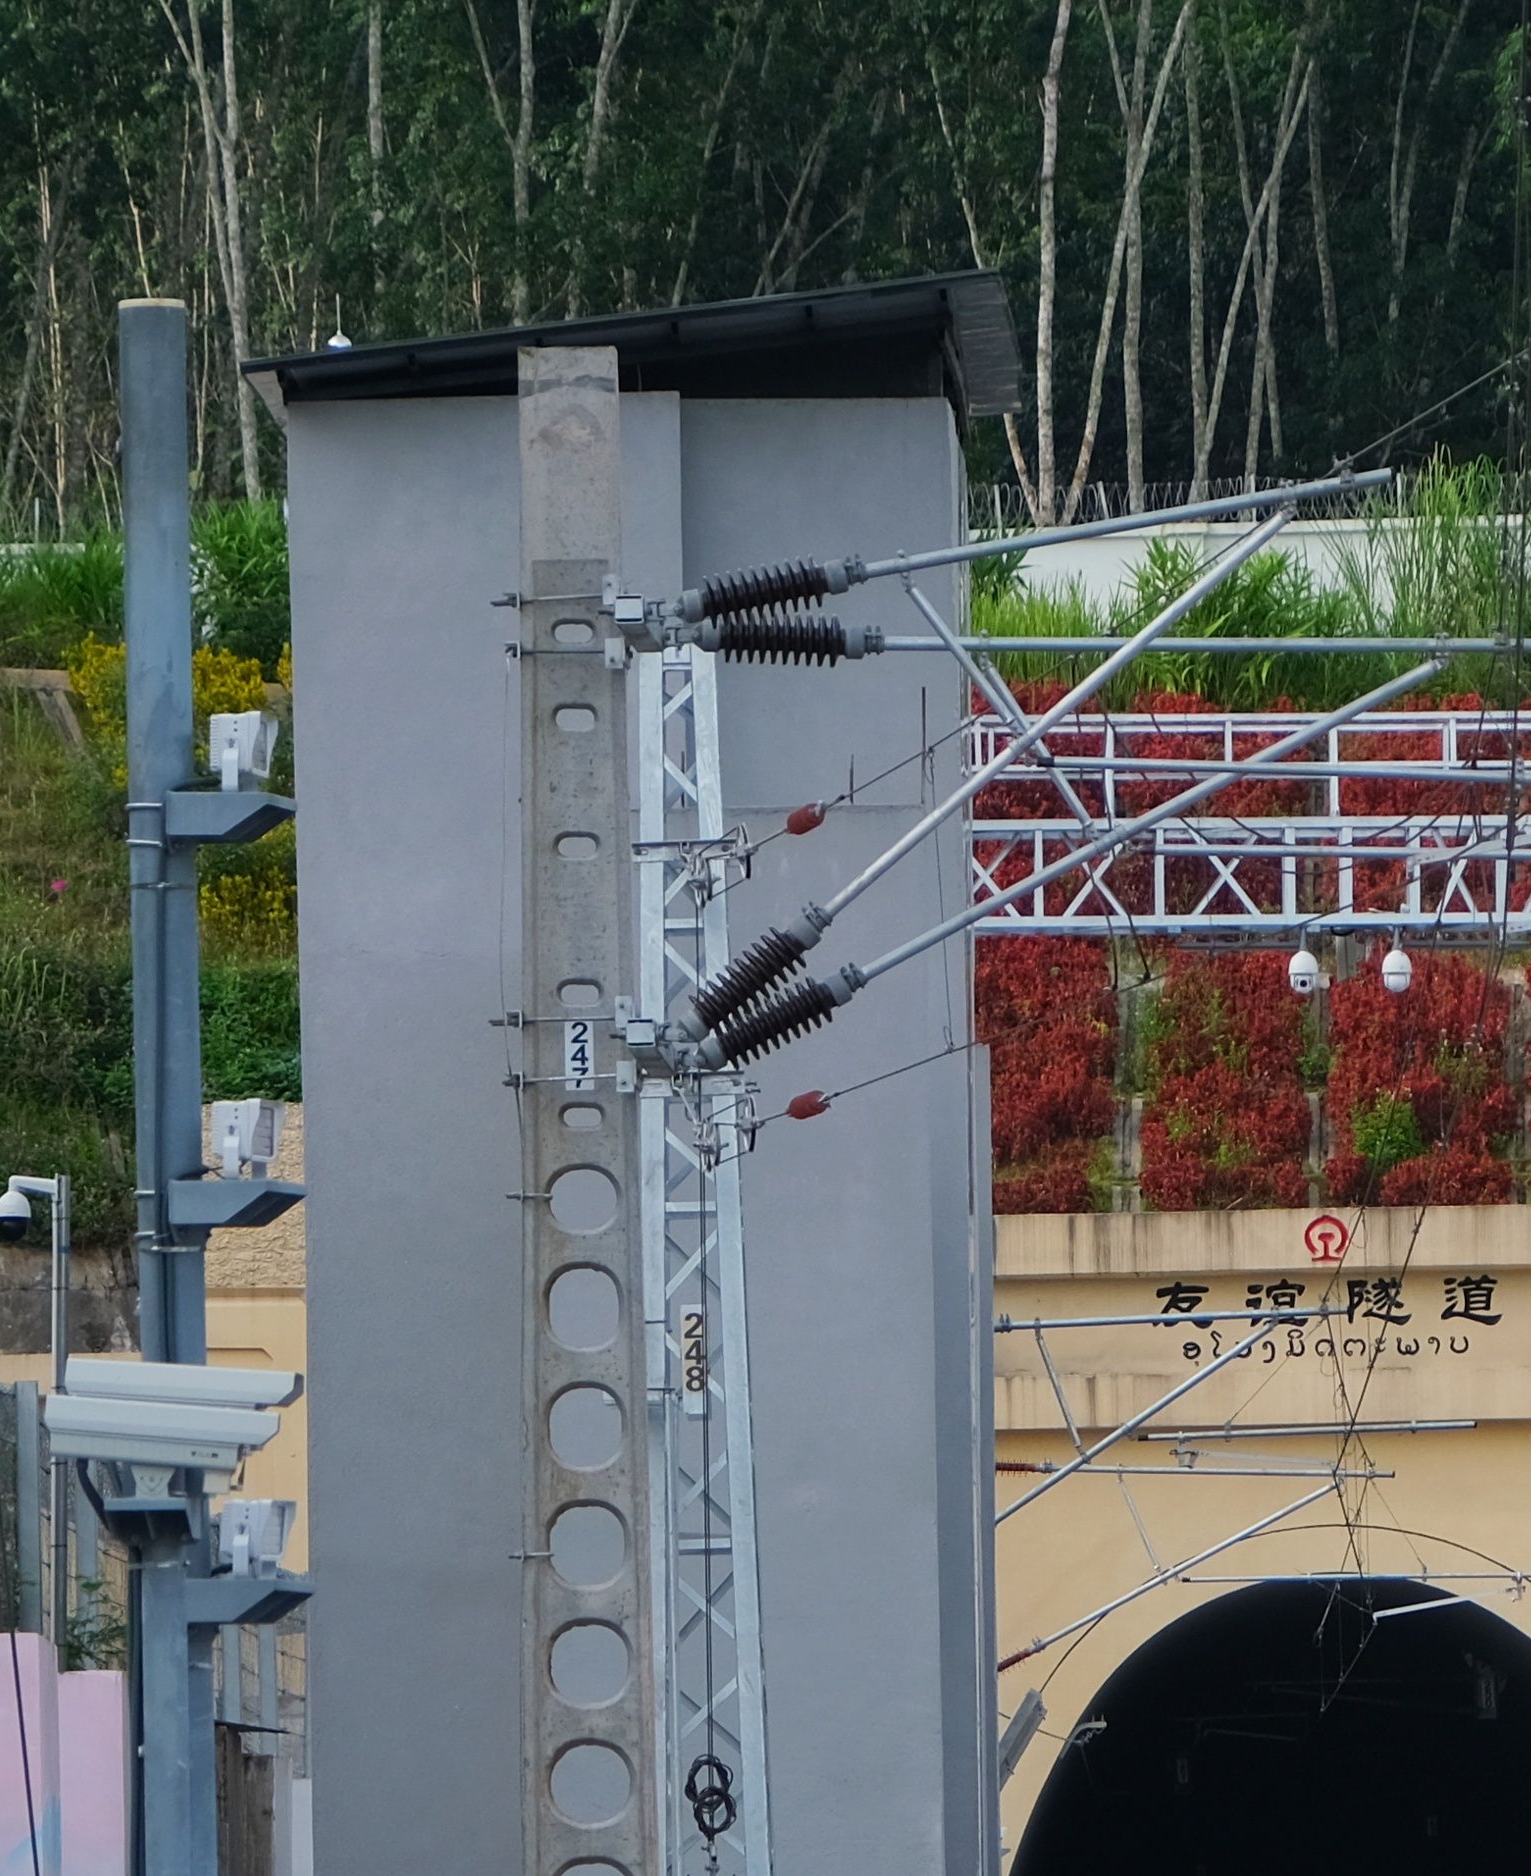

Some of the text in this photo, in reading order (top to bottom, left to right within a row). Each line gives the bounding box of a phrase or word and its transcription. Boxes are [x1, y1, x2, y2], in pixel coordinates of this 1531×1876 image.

[571, 1021, 589, 1089] 247
[1151, 1273, 1505, 1331] 友谊隧道
[683, 1312, 706, 1393] 248
